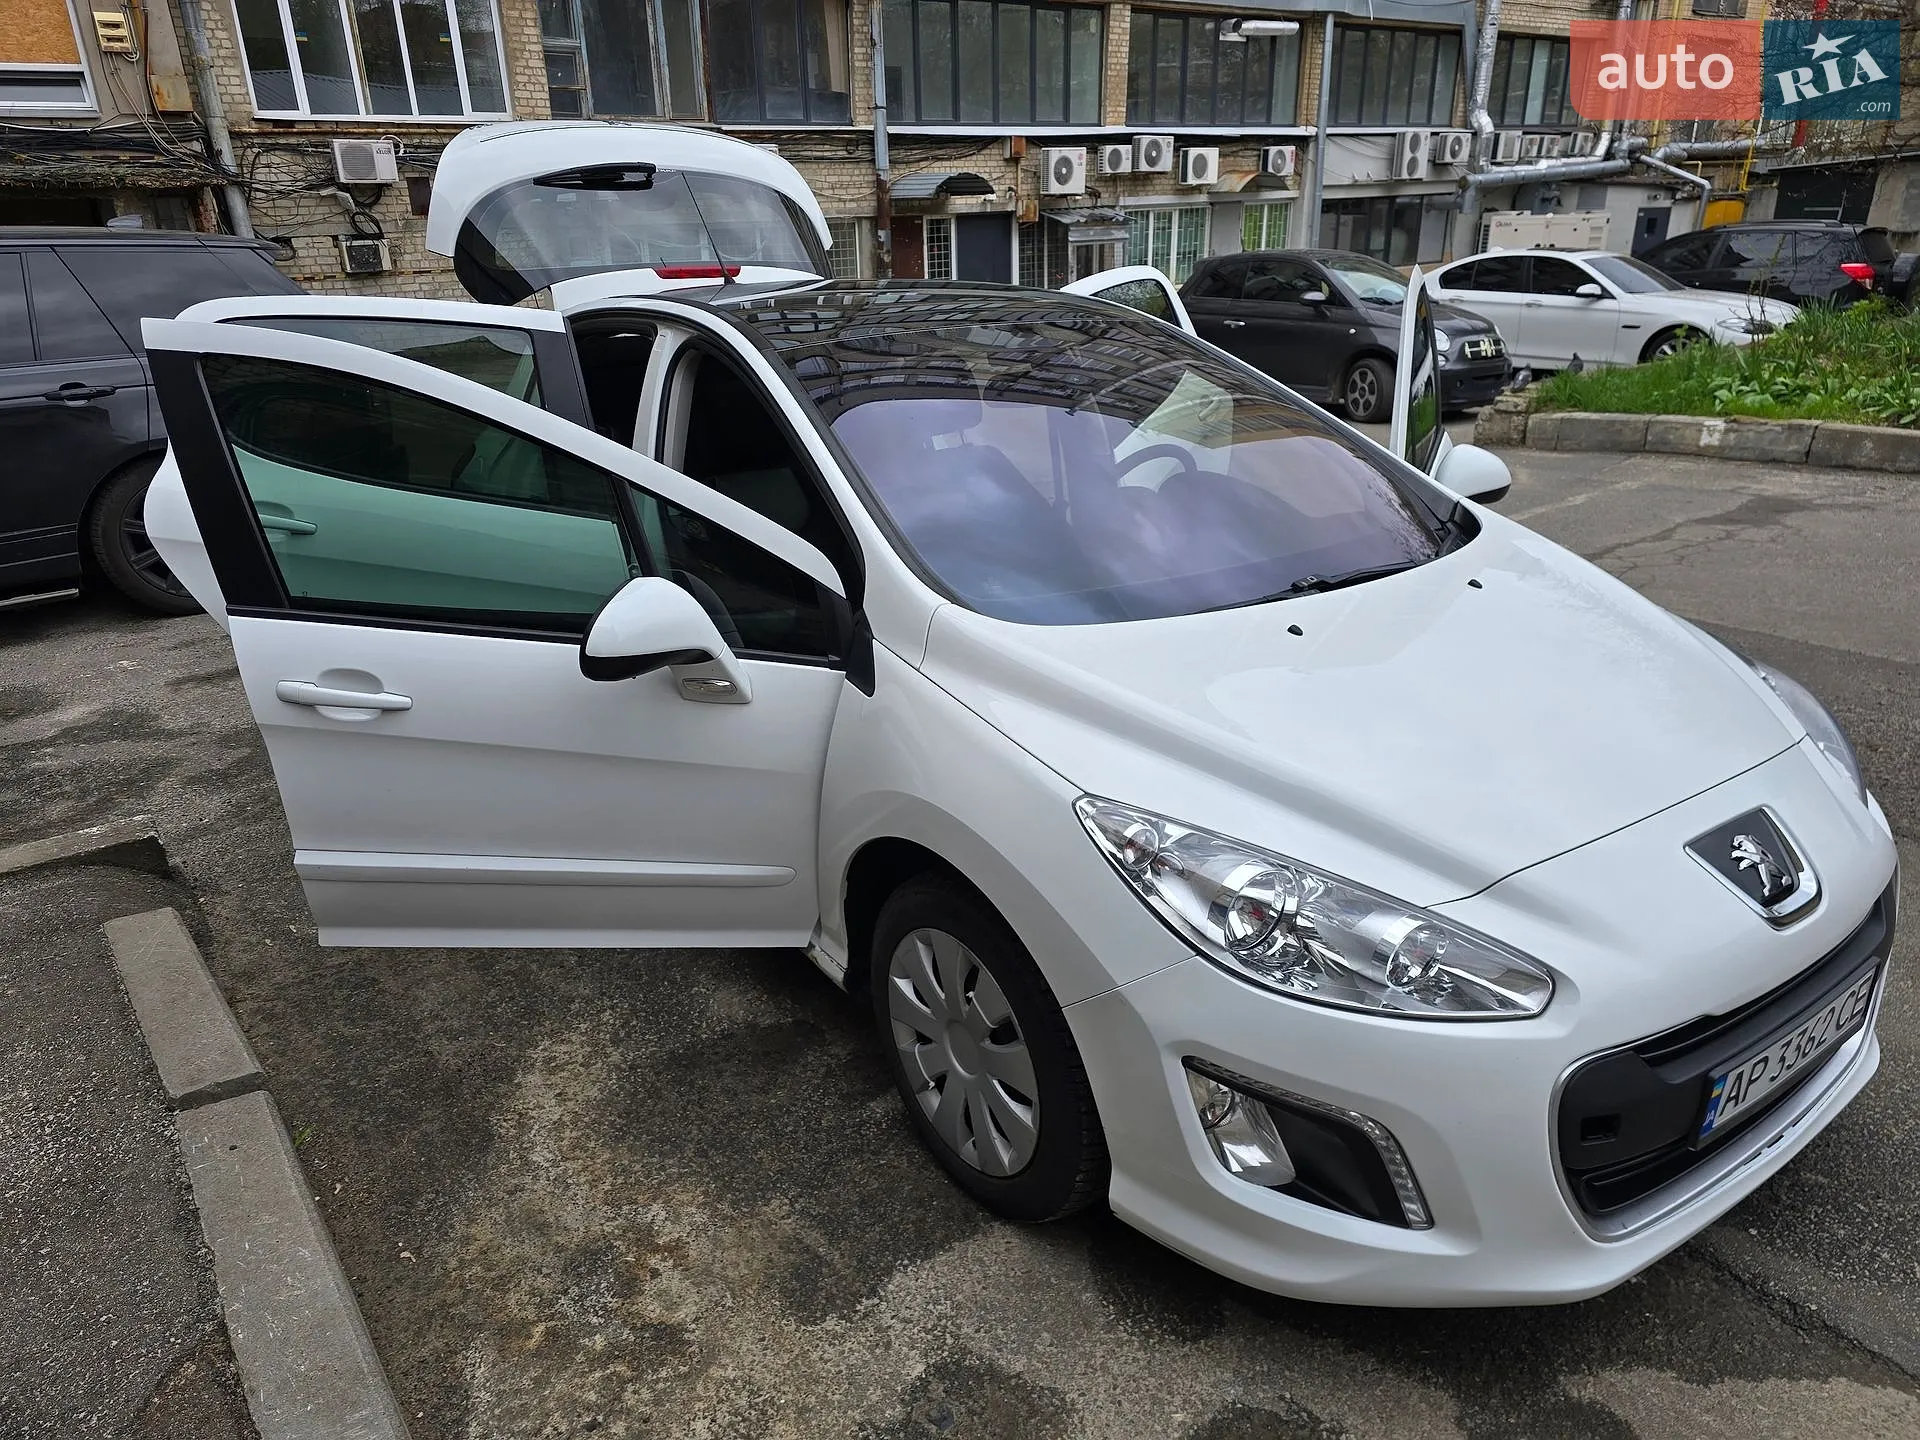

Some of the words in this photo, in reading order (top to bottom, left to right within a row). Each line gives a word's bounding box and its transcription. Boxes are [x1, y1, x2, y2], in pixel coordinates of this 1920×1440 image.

[1718, 1055, 1769, 1117] AP
[1769, 1006, 1835, 1083] 3362
[1836, 972, 1873, 1031] CE
